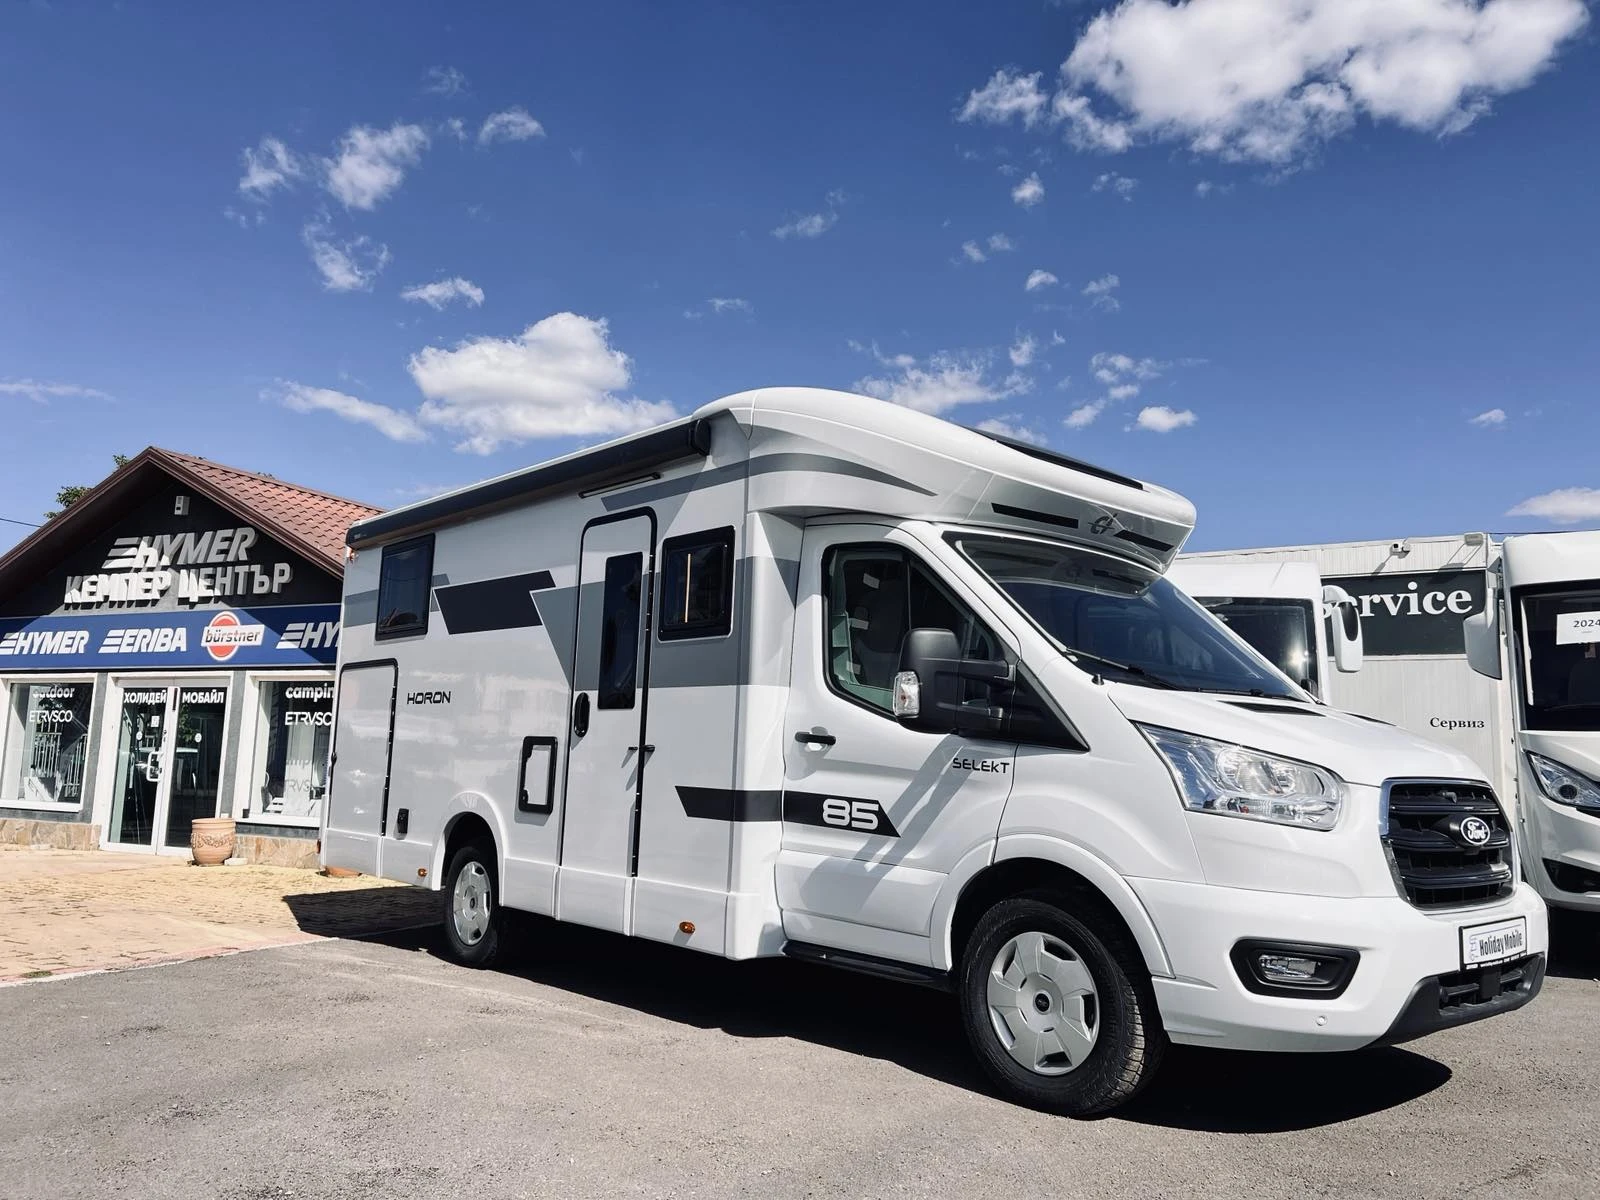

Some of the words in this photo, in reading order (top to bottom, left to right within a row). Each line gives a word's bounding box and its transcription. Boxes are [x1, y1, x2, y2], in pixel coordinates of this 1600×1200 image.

[134, 528, 255, 568] HYMER
[64, 570, 172, 604] КЕМПЕР
[178, 563, 291, 603] ЦЕНТЪР
[14, 630, 89, 655] HYMER
[119, 628, 187, 653] ERIBA
[205, 629, 261, 643] bürstner
[123, 689, 167, 705] ХОЛИДЕЙ
[182, 689, 224, 704] МОБАЙЛ
[285, 683, 334, 702] campin
[406, 690, 451, 705] HORON
[284, 711, 332, 726] ETRVSC
[1430, 717, 1485, 730] Сервиз
[952, 757, 1010, 774] SELEKT
[822, 798, 879, 830] 85
[1479, 935, 1504, 956] Holiday
[1504, 930, 1522, 950] Mobile
